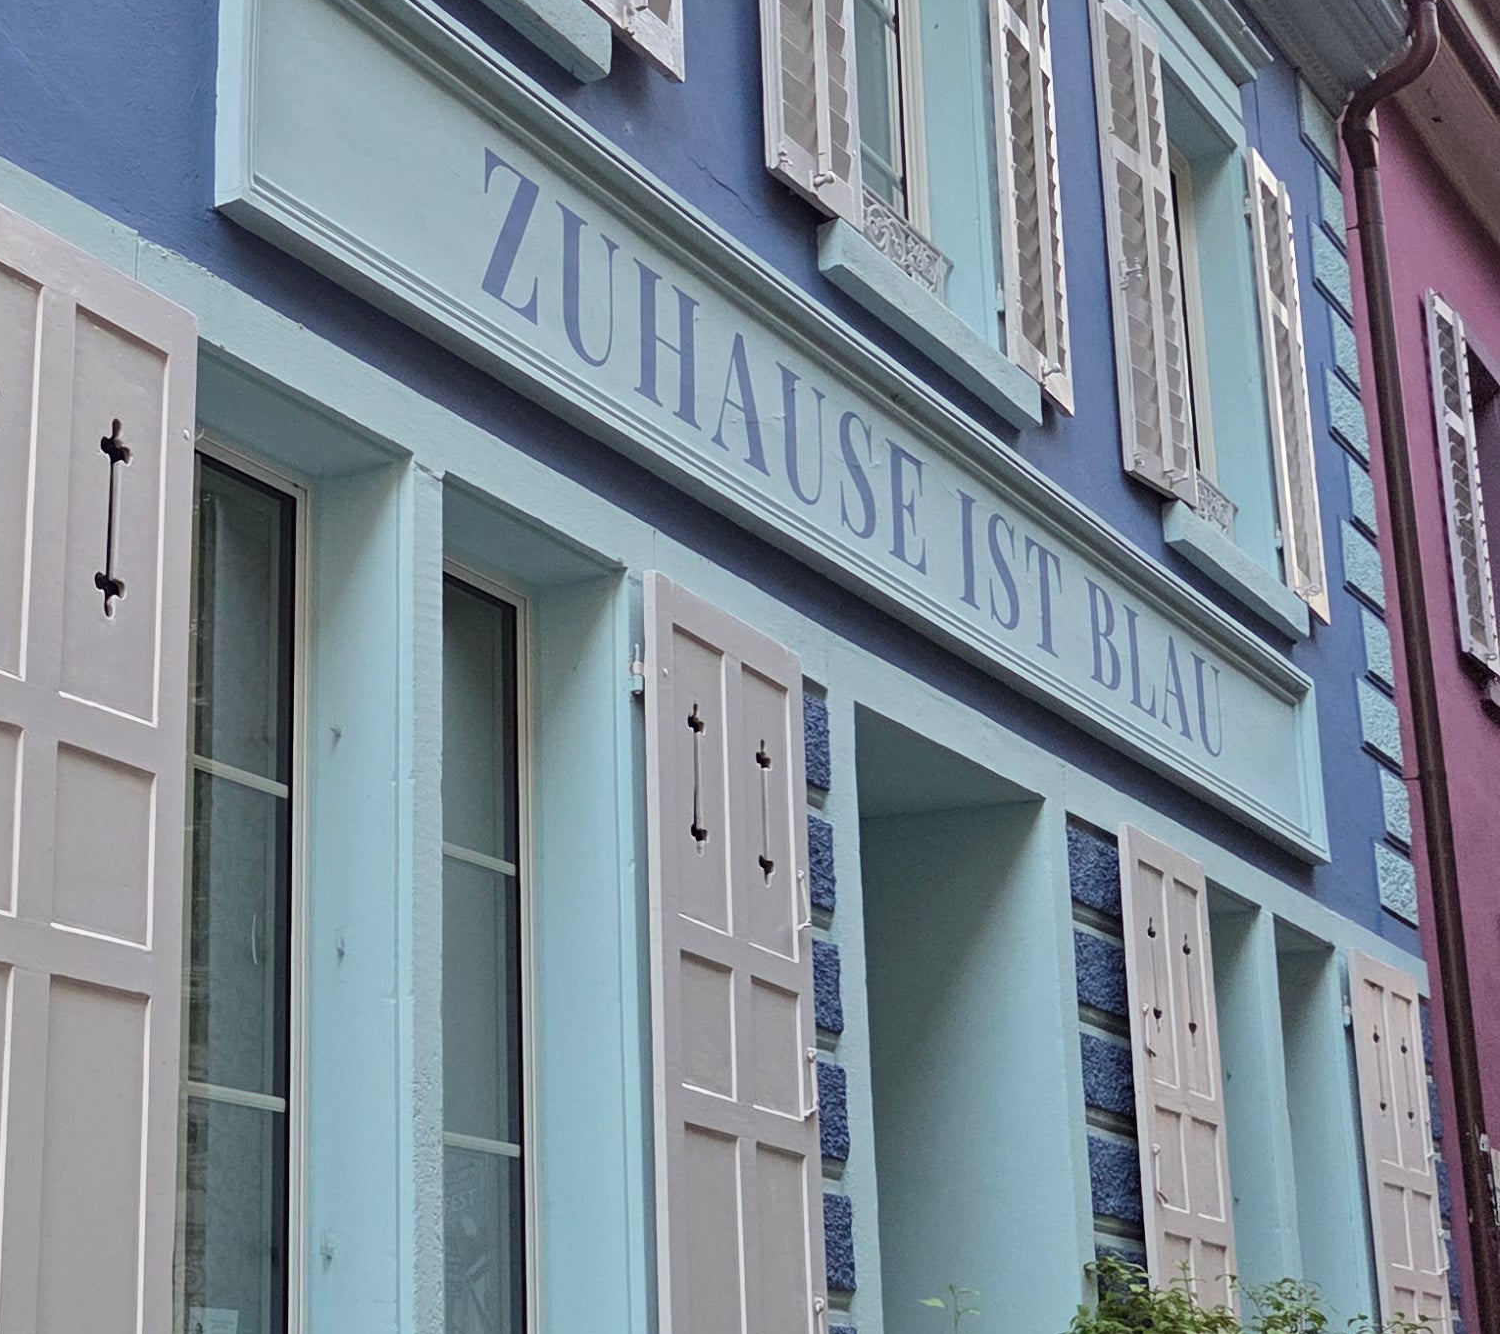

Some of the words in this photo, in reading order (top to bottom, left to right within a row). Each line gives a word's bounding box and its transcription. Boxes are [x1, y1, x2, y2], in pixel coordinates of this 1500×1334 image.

[481, 149, 927, 573] ZUHAUSE
[958, 492, 1062, 659] IST
[1084, 576, 1224, 758] BLAU
